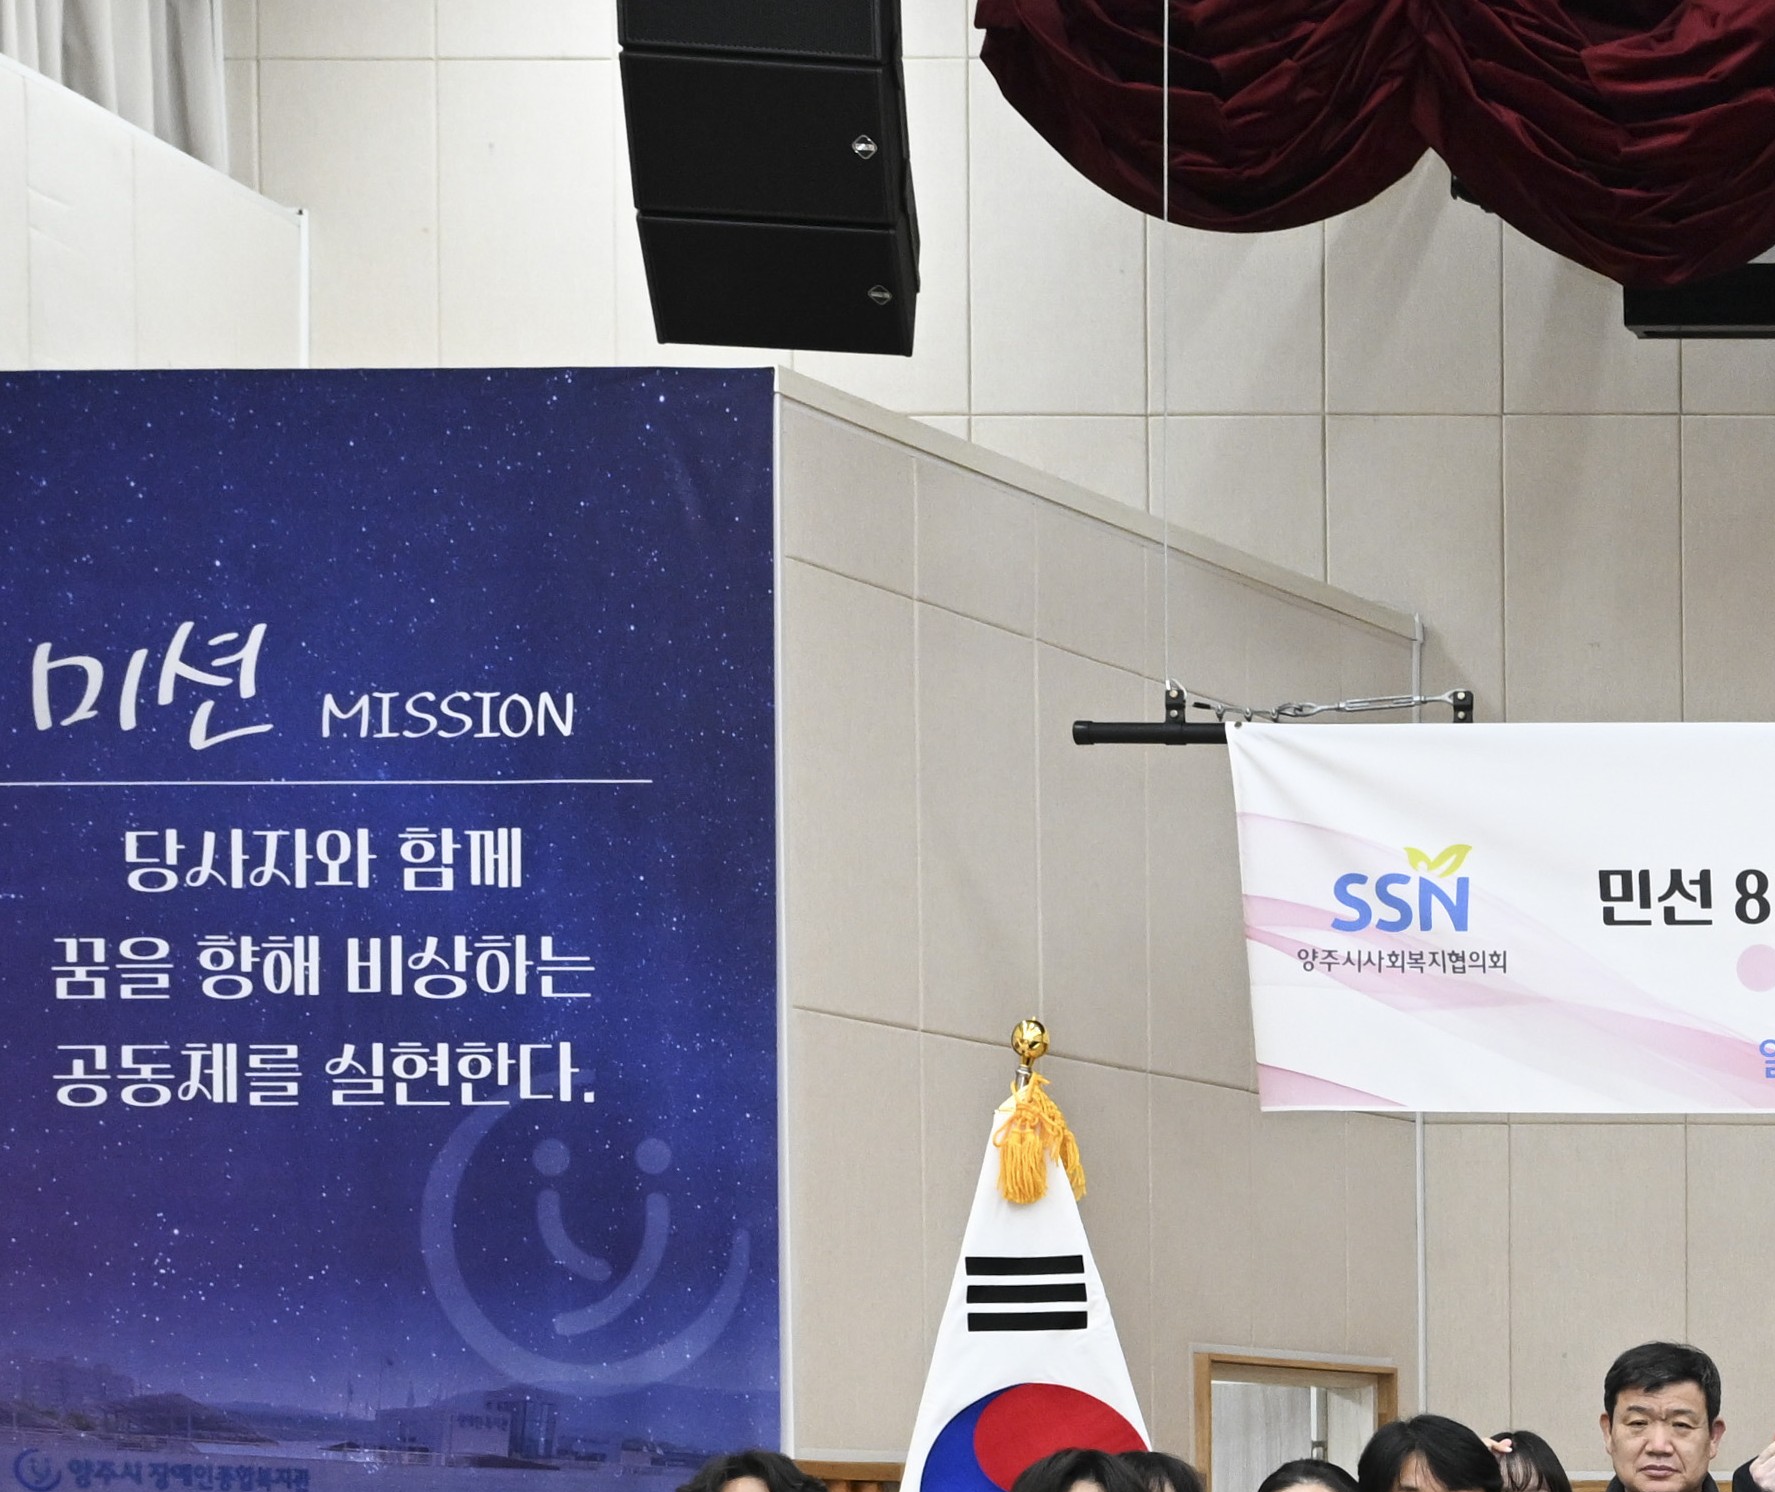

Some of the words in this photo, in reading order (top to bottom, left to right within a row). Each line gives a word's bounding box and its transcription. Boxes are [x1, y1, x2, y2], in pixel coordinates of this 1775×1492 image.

[33, 622, 273, 750] 미션
[322, 691, 573, 738] MISSION
[125, 828, 377, 892] 당사자와
[398, 828, 521, 891] 함께
[1332, 873, 1469, 932] SSN
[1599, 869, 1712, 926] 민선
[52, 937, 173, 999] 꿈을
[197, 936, 319, 999] 향해
[348, 935, 595, 999] 비상하는
[1298, 949, 1506, 973] 양주시사회복지협의회
[53, 1043, 302, 1106] 공동체를
[326, 1042, 594, 1105] 실현한다.
